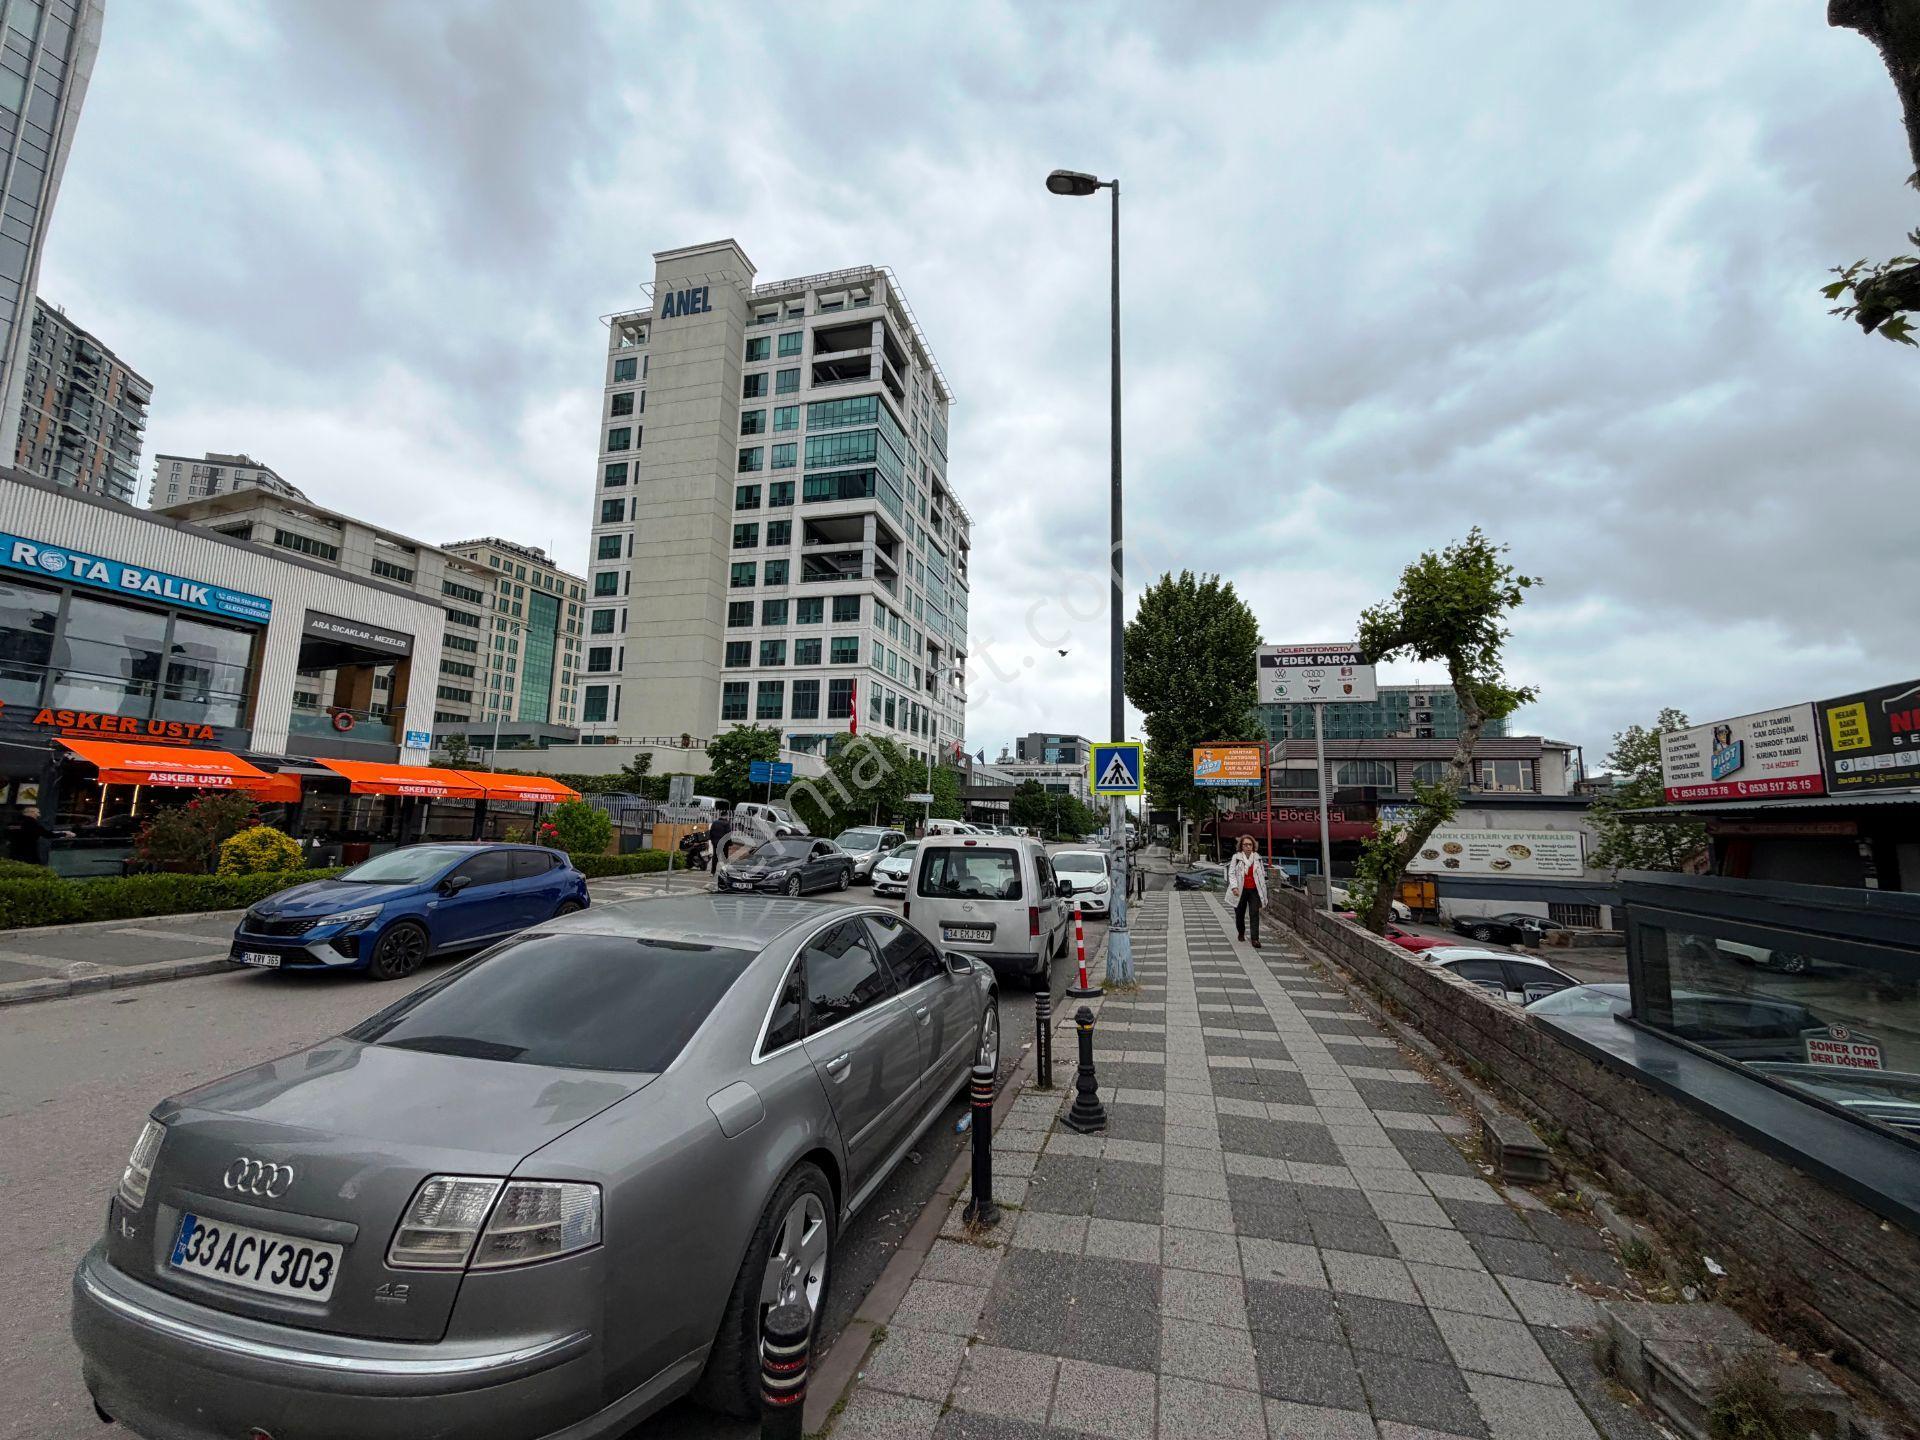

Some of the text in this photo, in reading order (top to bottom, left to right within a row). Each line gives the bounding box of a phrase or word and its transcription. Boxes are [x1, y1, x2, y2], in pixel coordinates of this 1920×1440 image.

[661, 286, 712, 319] ANEL
[11, 541, 210, 606] ROTA BALIK
[312, 620, 329, 630] ARA
[331, 624, 370, 639] SICAKLAR
[374, 635, 406, 648] MEZELER
[1274, 655, 1357, 666] YEDEK PARÇA
[33, 708, 139, 734] ASKER
[147, 719, 215, 739] USTA
[1769, 714, 1792, 726] TAMİRİ
[1753, 730, 1767, 738] CAM
[1755, 733, 1809, 748] SUNROOF TAMİRİ
[1779, 746, 1802, 757] TAMİRİ
[148, 772, 234, 785] ASKER USTA
[398, 785, 448, 795] ASKER USTA
[1710, 787, 1719, 795] 75
[1720, 786, 1729, 794] 76
[1749, 780, 1811, 793] 0538 517 36 15
[948, 929, 958, 938] 34
[975, 930, 991, 940] 847
[1809, 1041, 1877, 1057] SONER OTO
